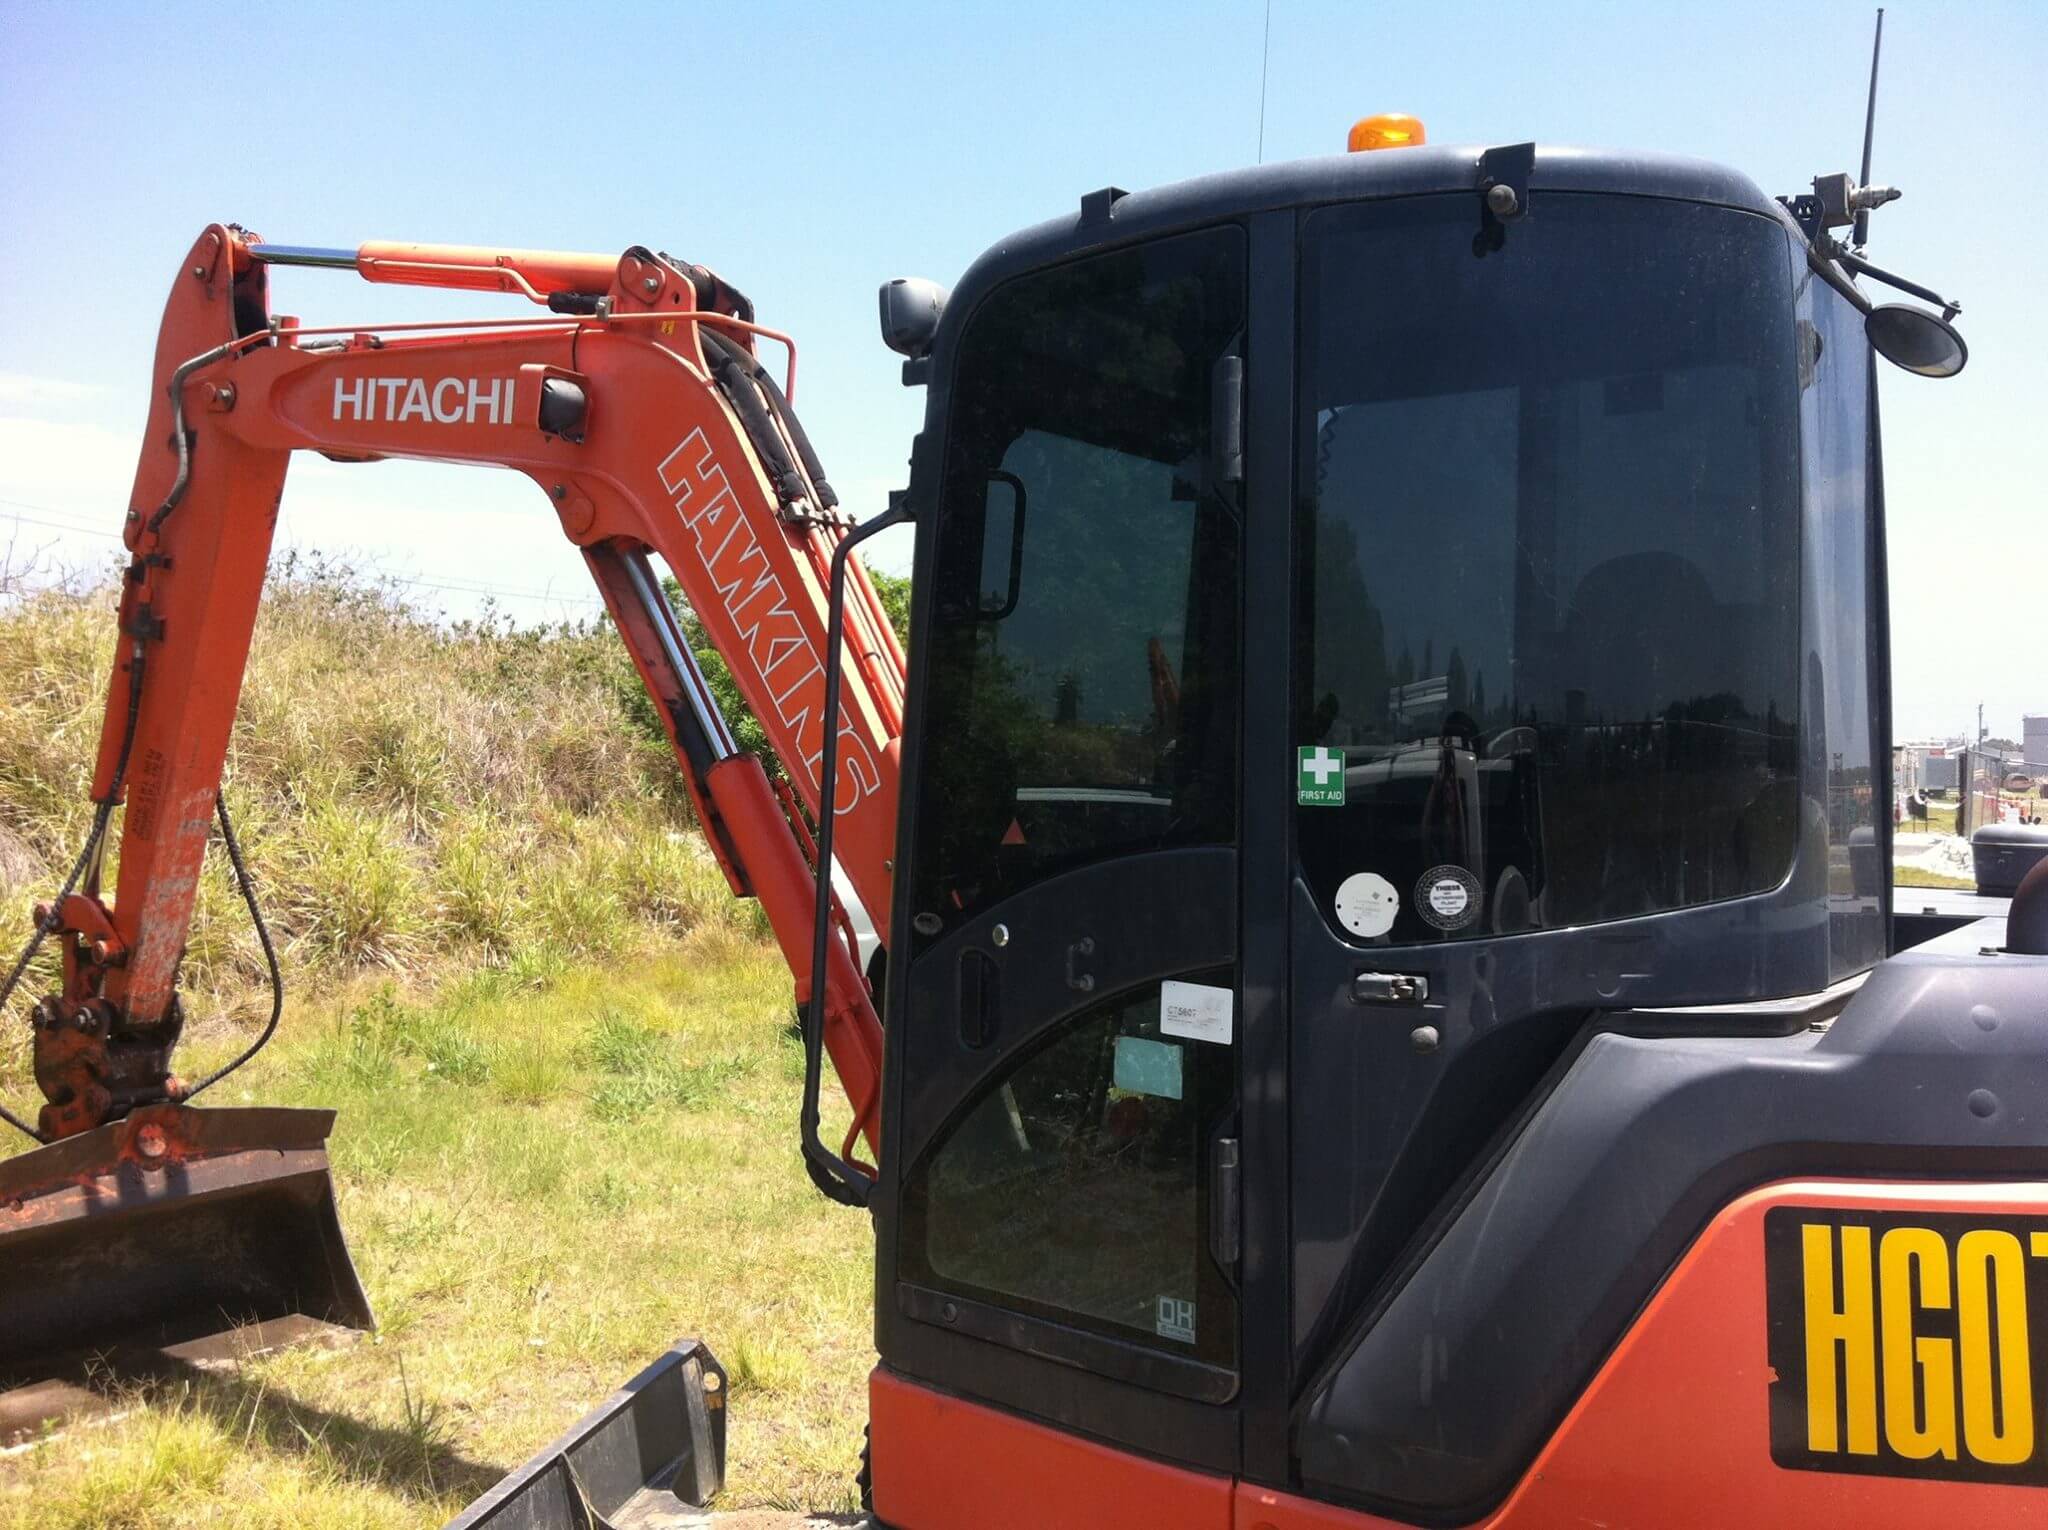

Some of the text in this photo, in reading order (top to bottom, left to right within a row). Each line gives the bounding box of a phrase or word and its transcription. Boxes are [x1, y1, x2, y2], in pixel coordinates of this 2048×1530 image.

[333, 377, 515, 424] HITACHI
[657, 425, 881, 816] HAWKINS
[1300, 790, 1342, 800] FIRST AID
